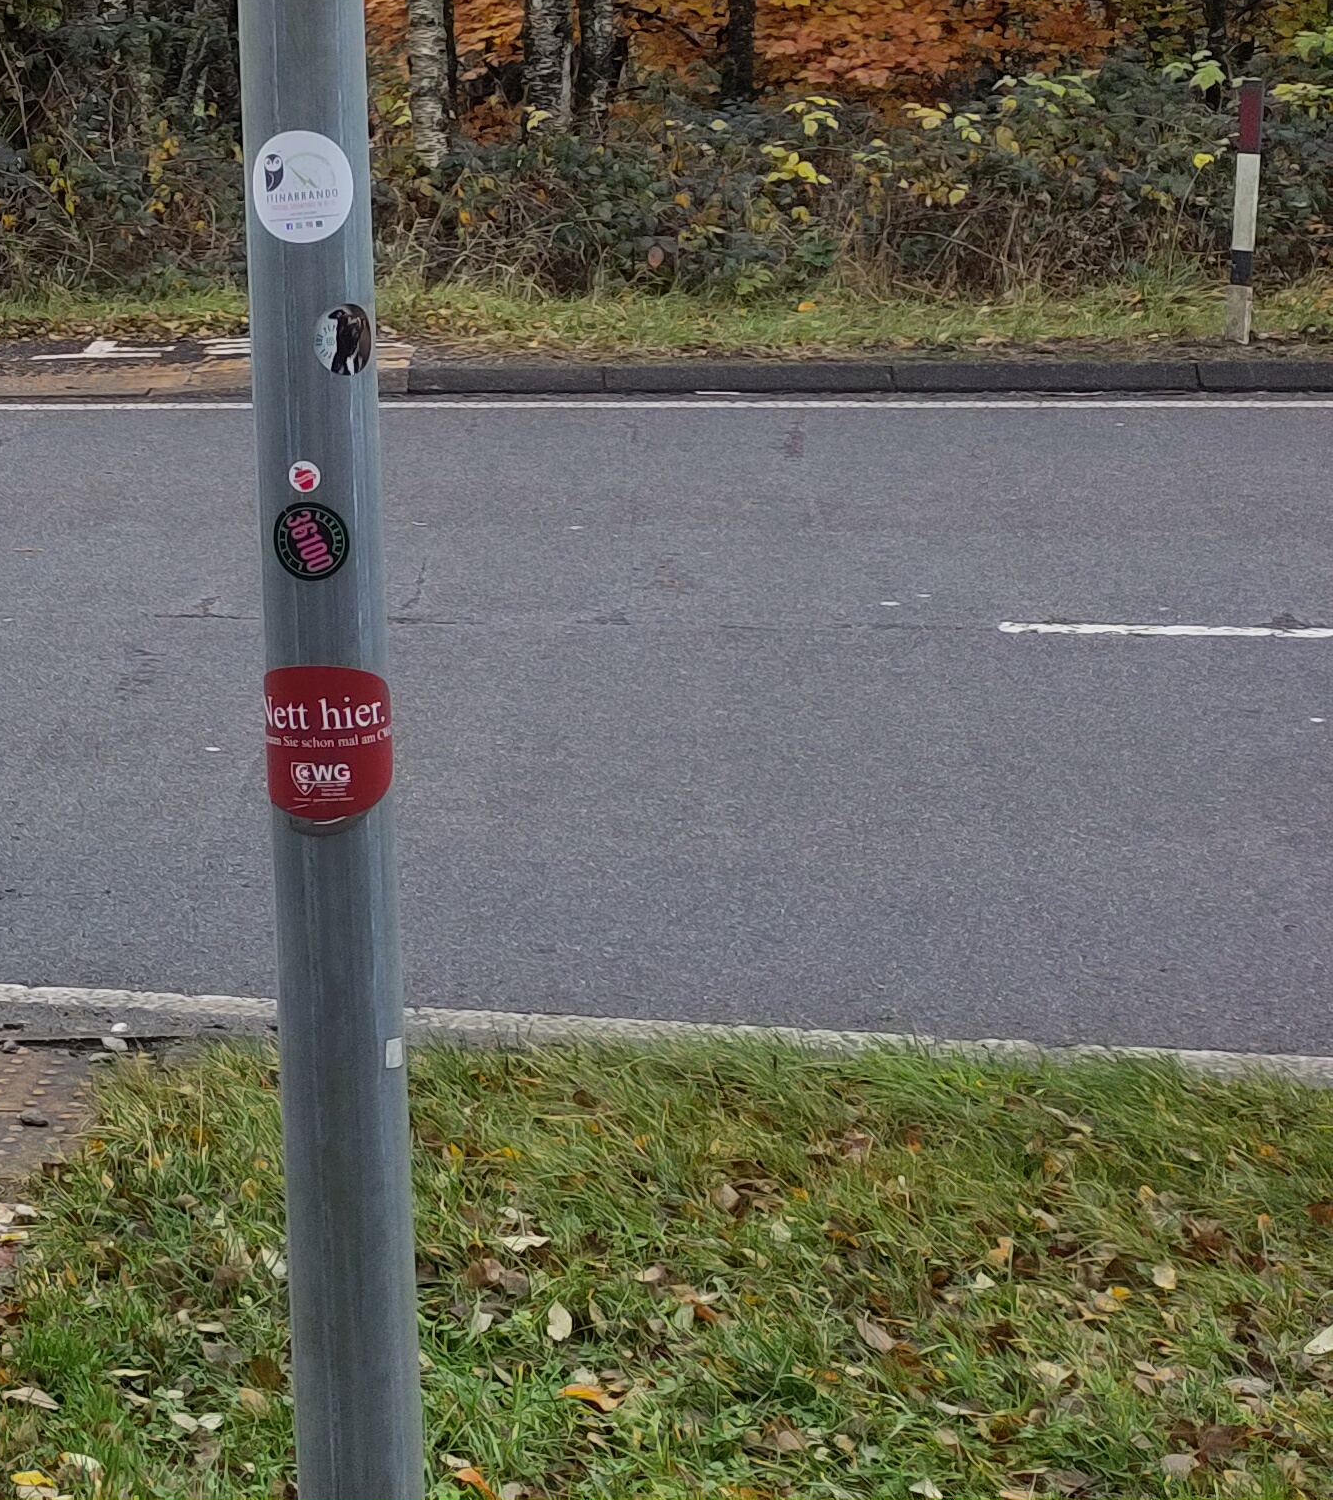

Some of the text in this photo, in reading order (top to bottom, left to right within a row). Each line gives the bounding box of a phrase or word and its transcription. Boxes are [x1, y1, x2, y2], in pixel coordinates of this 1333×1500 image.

[286, 510, 334, 573] 36100
[318, 696, 386, 731] hier.
[283, 735, 300, 748] Sie
[301, 736, 335, 749] schon
[337, 734, 359, 747] mal
[295, 763, 352, 782] CWG
